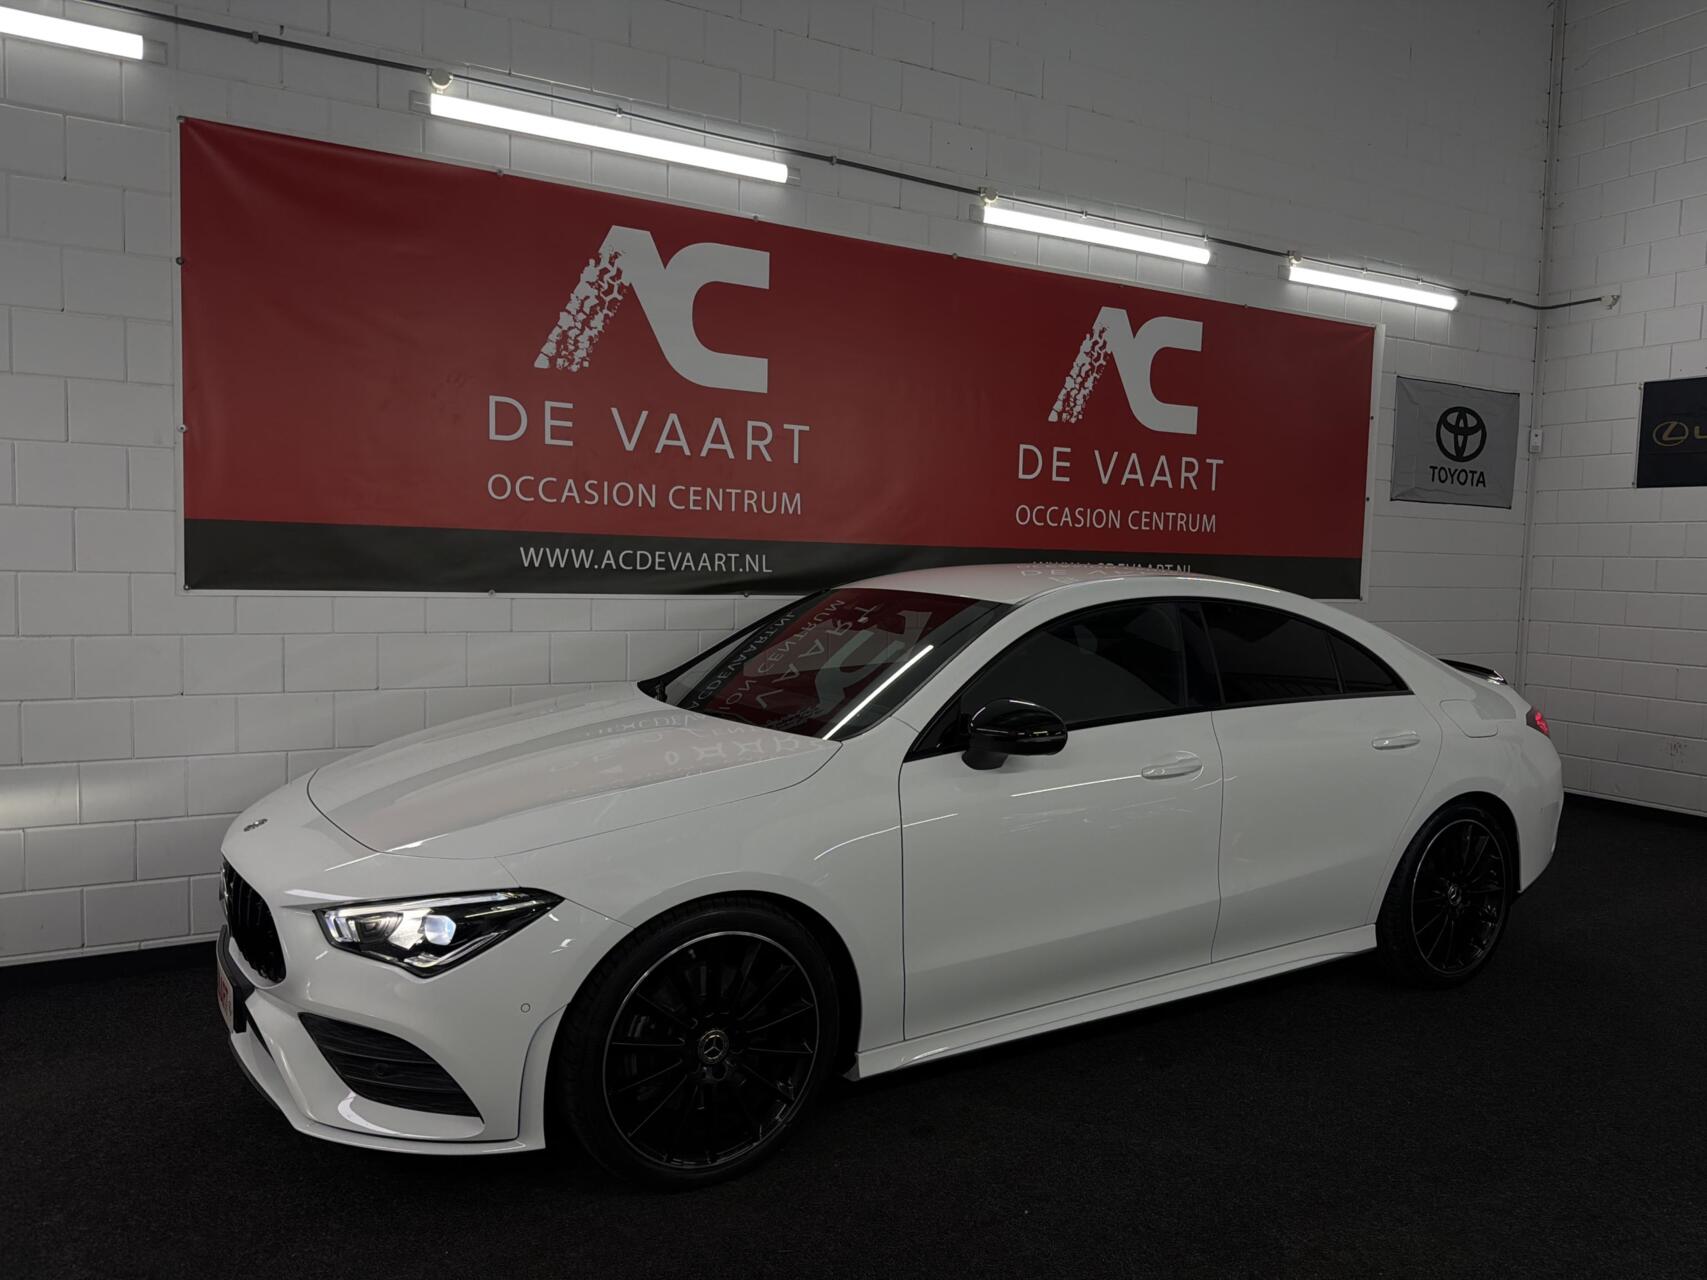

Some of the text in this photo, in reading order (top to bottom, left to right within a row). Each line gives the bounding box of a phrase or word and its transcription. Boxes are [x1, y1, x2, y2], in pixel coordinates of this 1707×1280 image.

[533, 225, 771, 394] AC
[1047, 305, 1204, 435] AC
[488, 395, 810, 465] DE VAART
[1017, 443, 1224, 492] DE VAART
[1429, 466, 1487, 488] TOYOTA
[487, 473, 802, 515] OCCASION CENTRUM
[1015, 504, 1217, 533] OCCASION CENTRUM
[519, 546, 774, 574] WWW.ACDEVAART.NL
